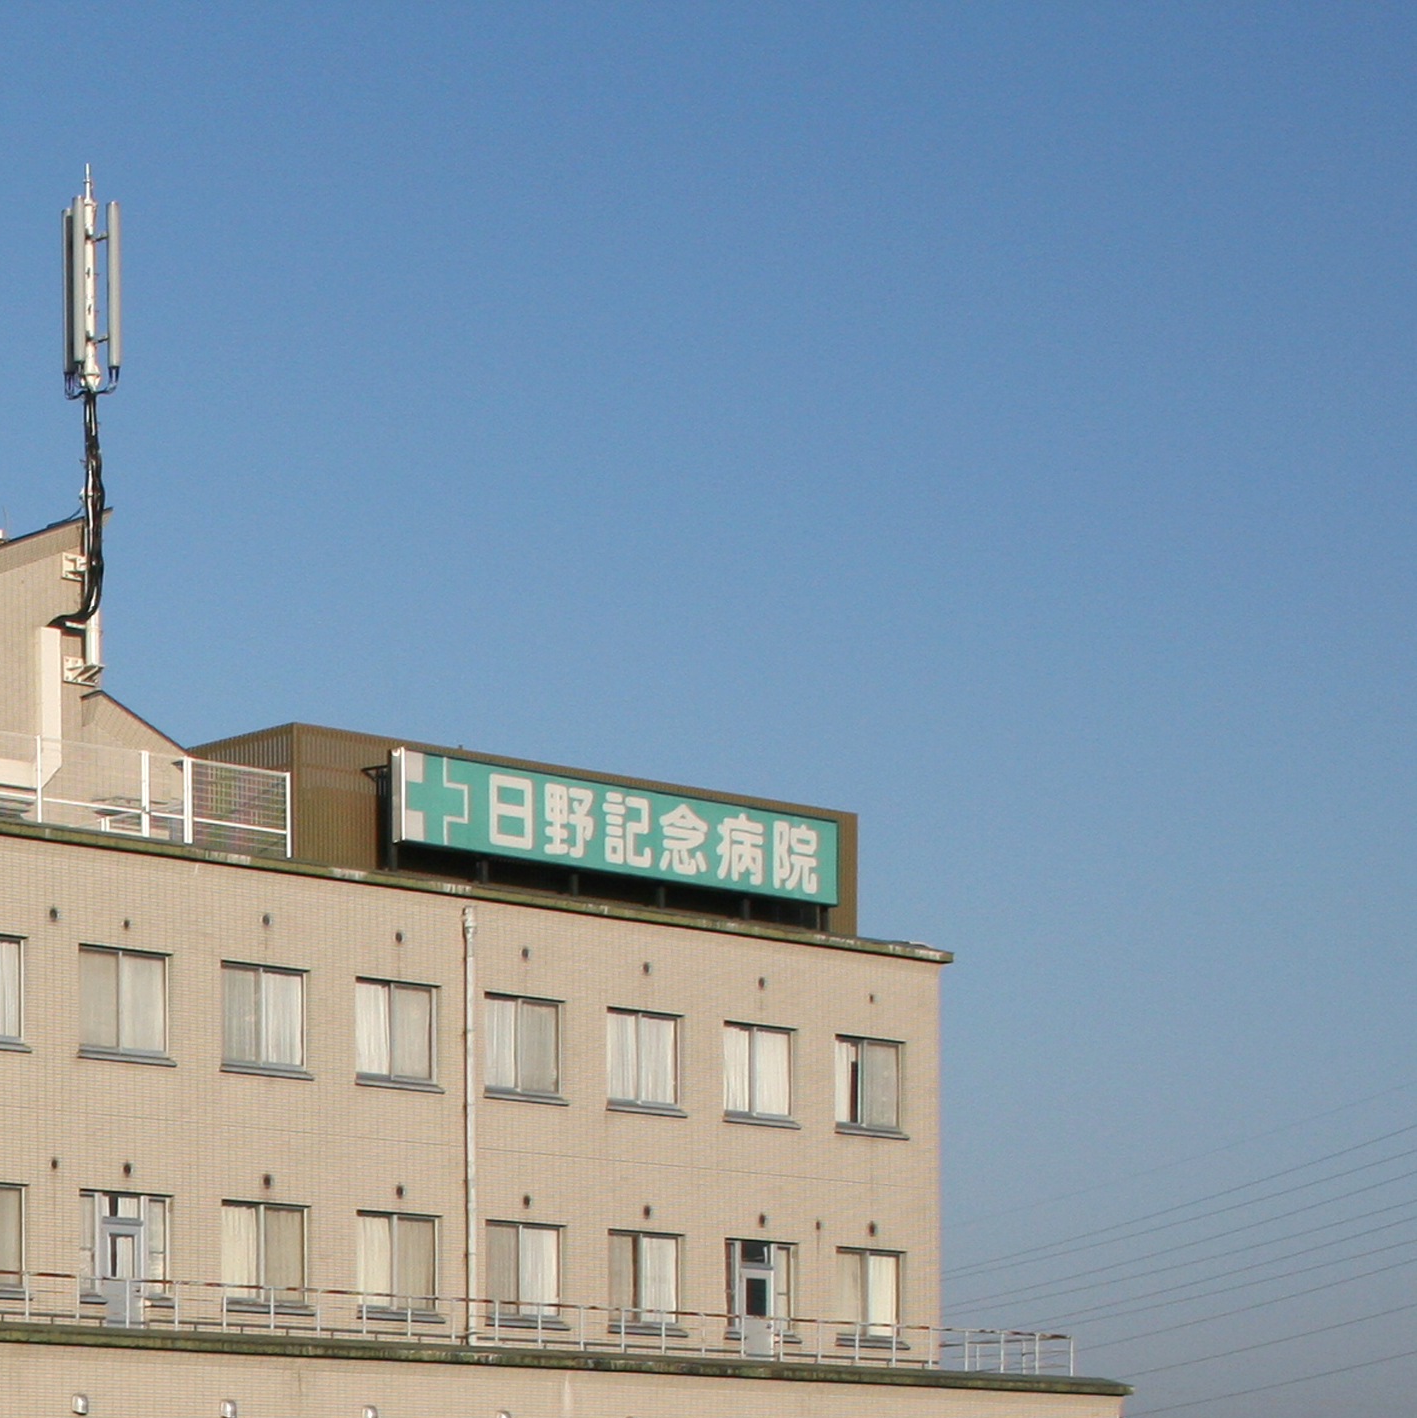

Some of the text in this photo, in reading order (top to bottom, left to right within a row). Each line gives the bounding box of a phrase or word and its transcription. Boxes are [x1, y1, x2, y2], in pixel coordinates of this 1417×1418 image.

[487, 771, 820, 896] 日野記念病院
